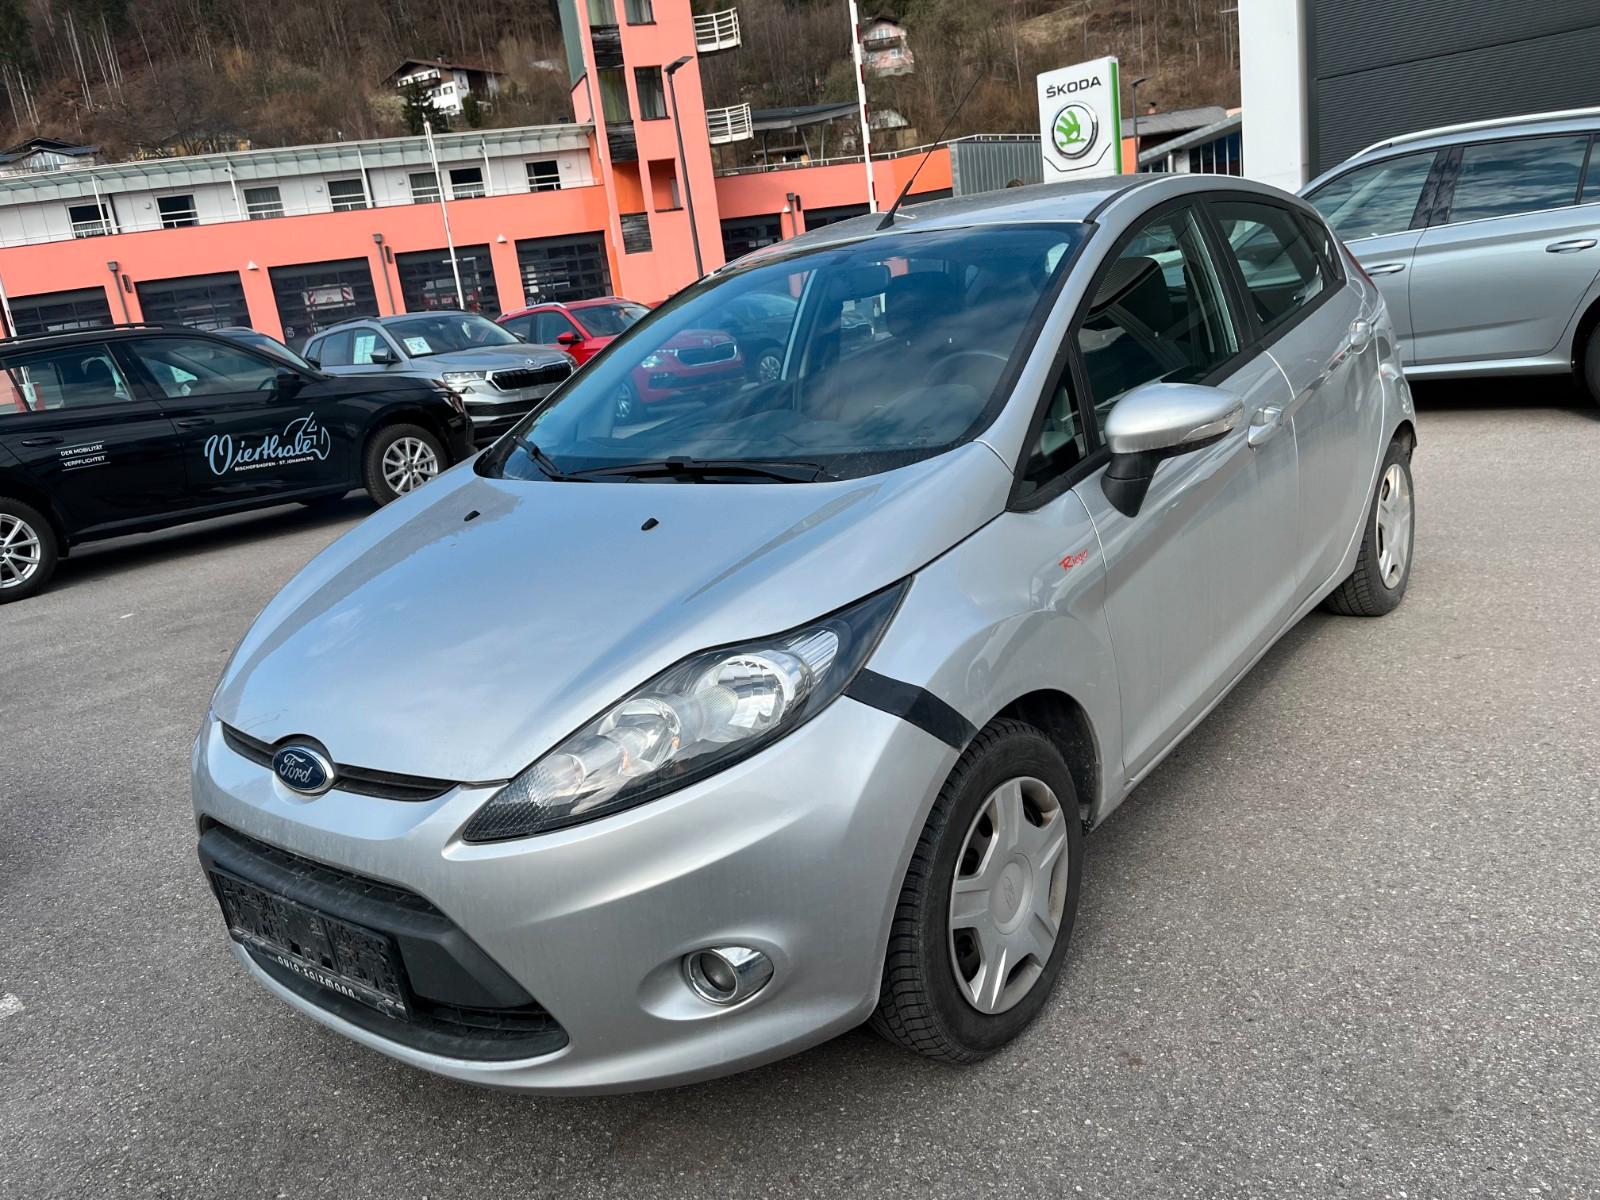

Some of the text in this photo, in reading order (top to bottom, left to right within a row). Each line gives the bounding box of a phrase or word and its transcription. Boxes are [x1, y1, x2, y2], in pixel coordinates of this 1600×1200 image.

[1046, 76, 1102, 99] ŠKODA
[63, 455, 105, 467] VERPFLICHTET
[280, 753, 314, 783] Ford
